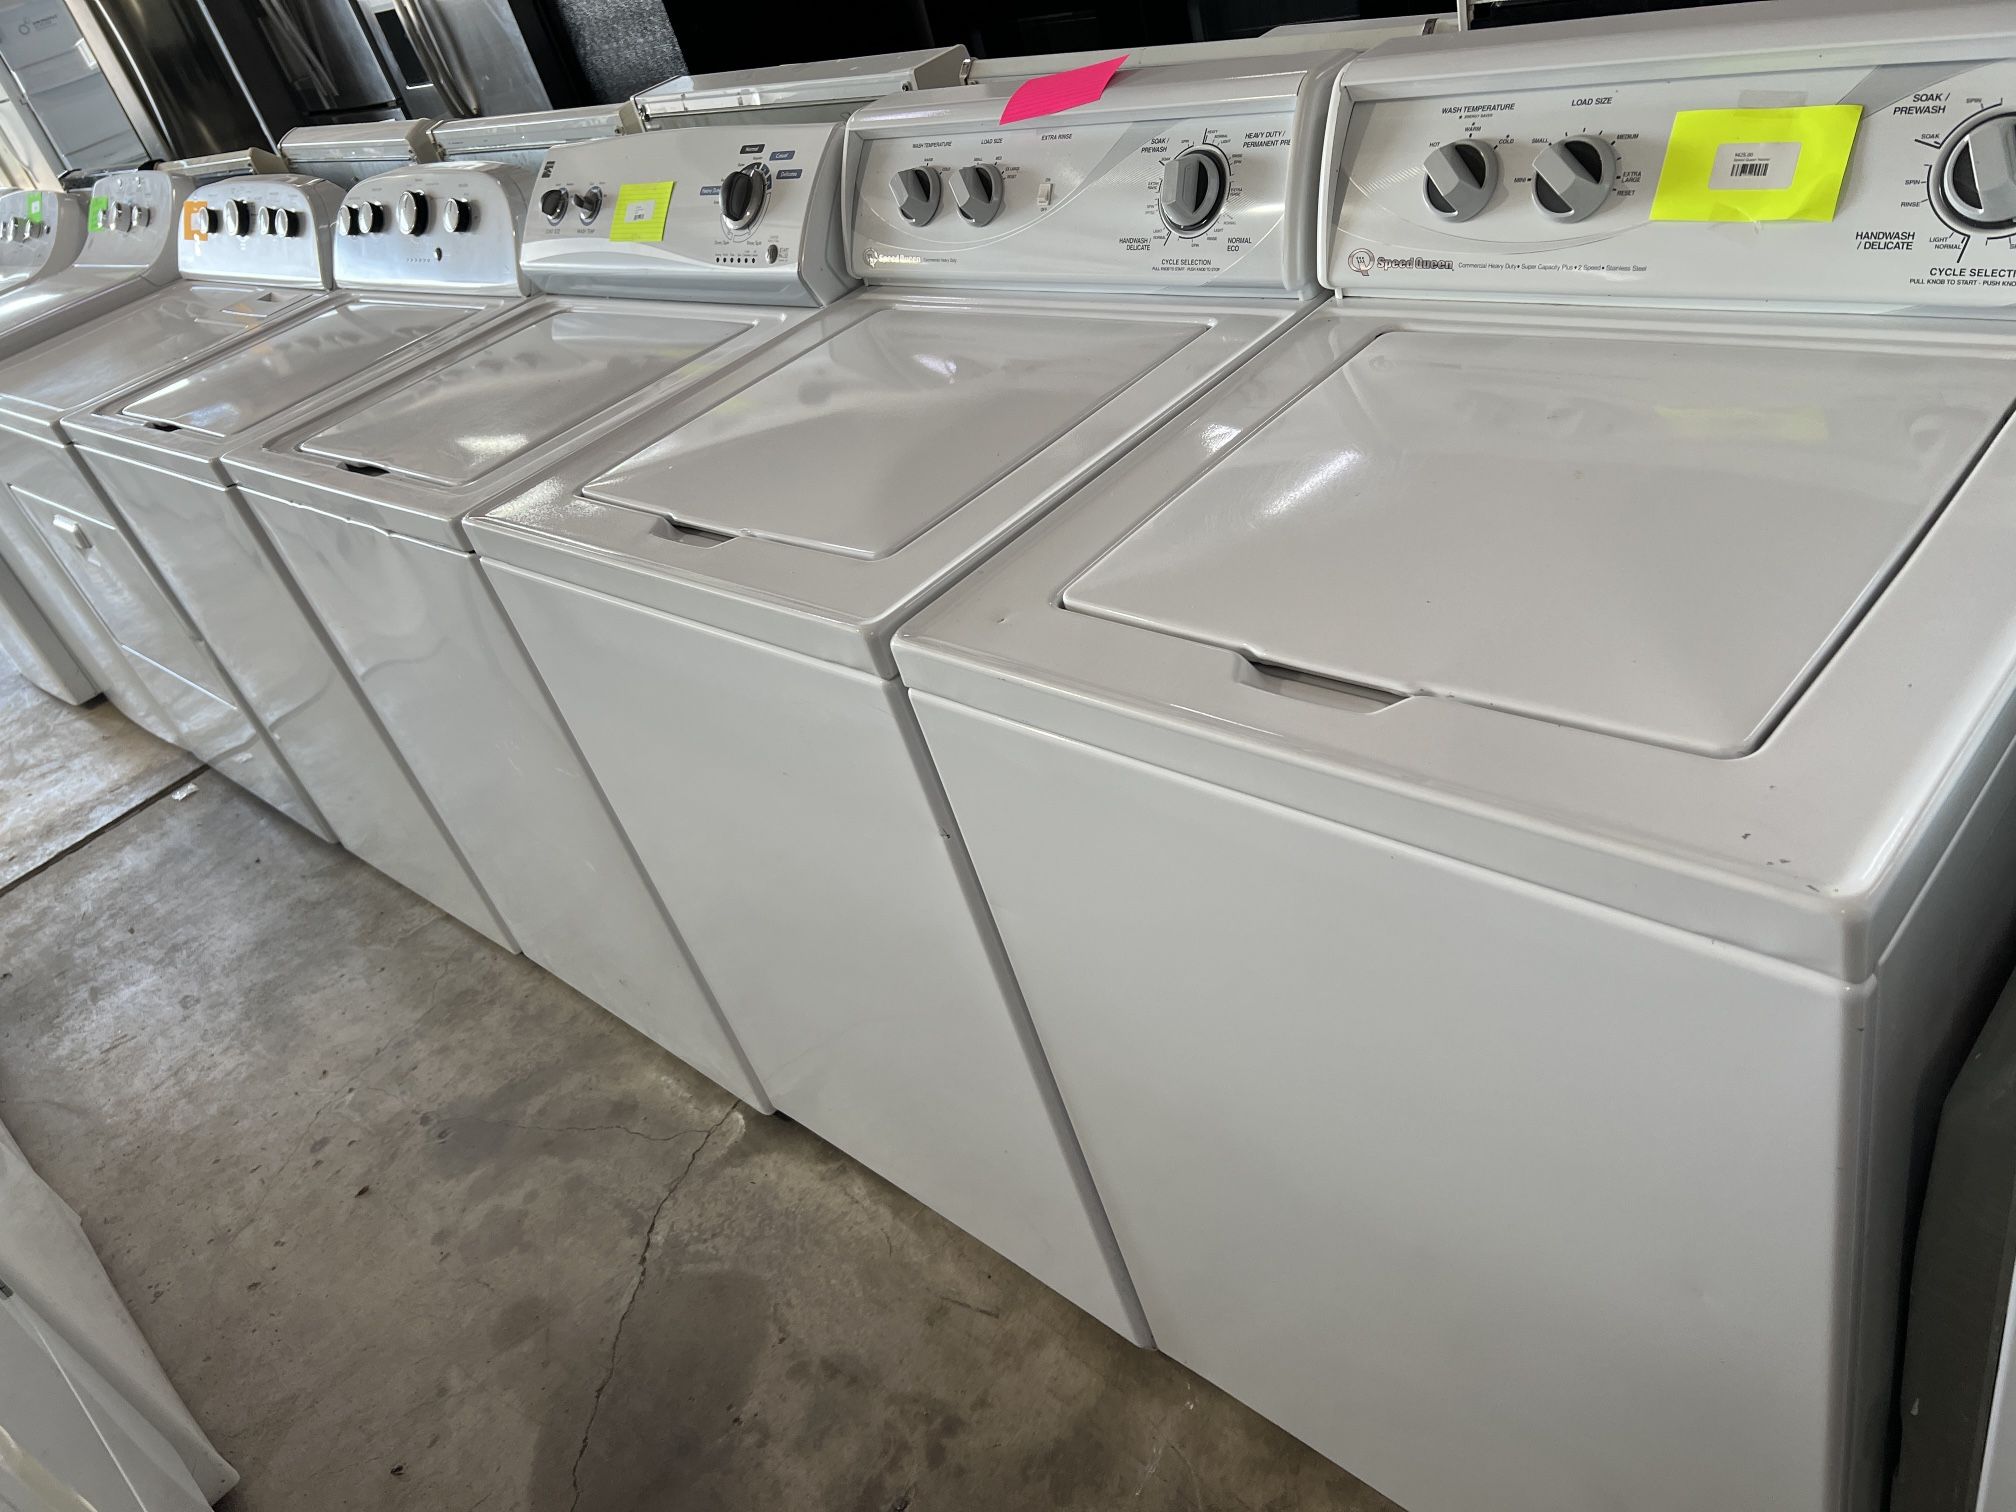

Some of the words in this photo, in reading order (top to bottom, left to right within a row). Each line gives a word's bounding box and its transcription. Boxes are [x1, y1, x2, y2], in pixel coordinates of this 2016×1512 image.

[1571, 98, 1593, 106] LOAD
[1594, 97, 1612, 105] SIZE
[1913, 93, 1943, 102] SOAK
[1463, 103, 1515, 113] TEMPERATURE
[1893, 105, 1946, 115] PREWASH
[1245, 131, 1265, 139] HEAVY
[1242, 140, 1279, 148] PERMANENT
[1855, 232, 1915, 240] HANDWASH
[1864, 241, 1913, 250] DELICATE
[1377, 257, 1414, 270] Speed
[1415, 257, 1453, 270] Queen
[1930, 268, 1966, 276] CYCLE
